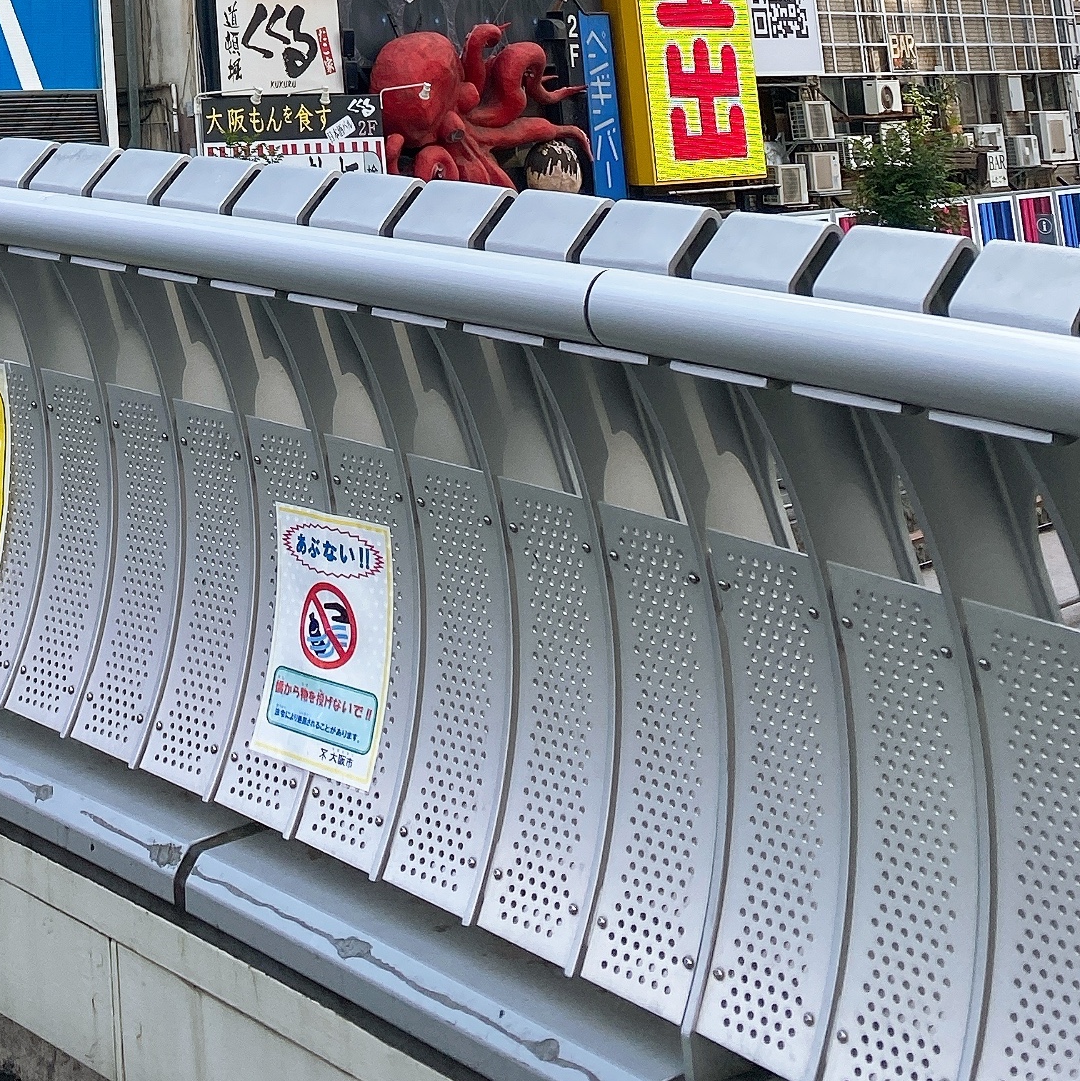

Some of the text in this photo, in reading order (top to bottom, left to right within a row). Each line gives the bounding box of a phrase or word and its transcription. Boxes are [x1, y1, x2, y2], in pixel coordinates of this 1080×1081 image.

[223, 1, 243, 83] 道頓堀
[241, 2, 319, 79] くくる
[889, 34, 917, 59] BAR
[270, 80, 297, 89] KUKURU
[205, 103, 332, 135] 大阪もんを食す
[586, 30, 619, 189] ペンギンバー
[358, 120, 378, 136] 2F
[988, 155, 1007, 171] BAR
[297, 534, 370, 570] あぶない!!
